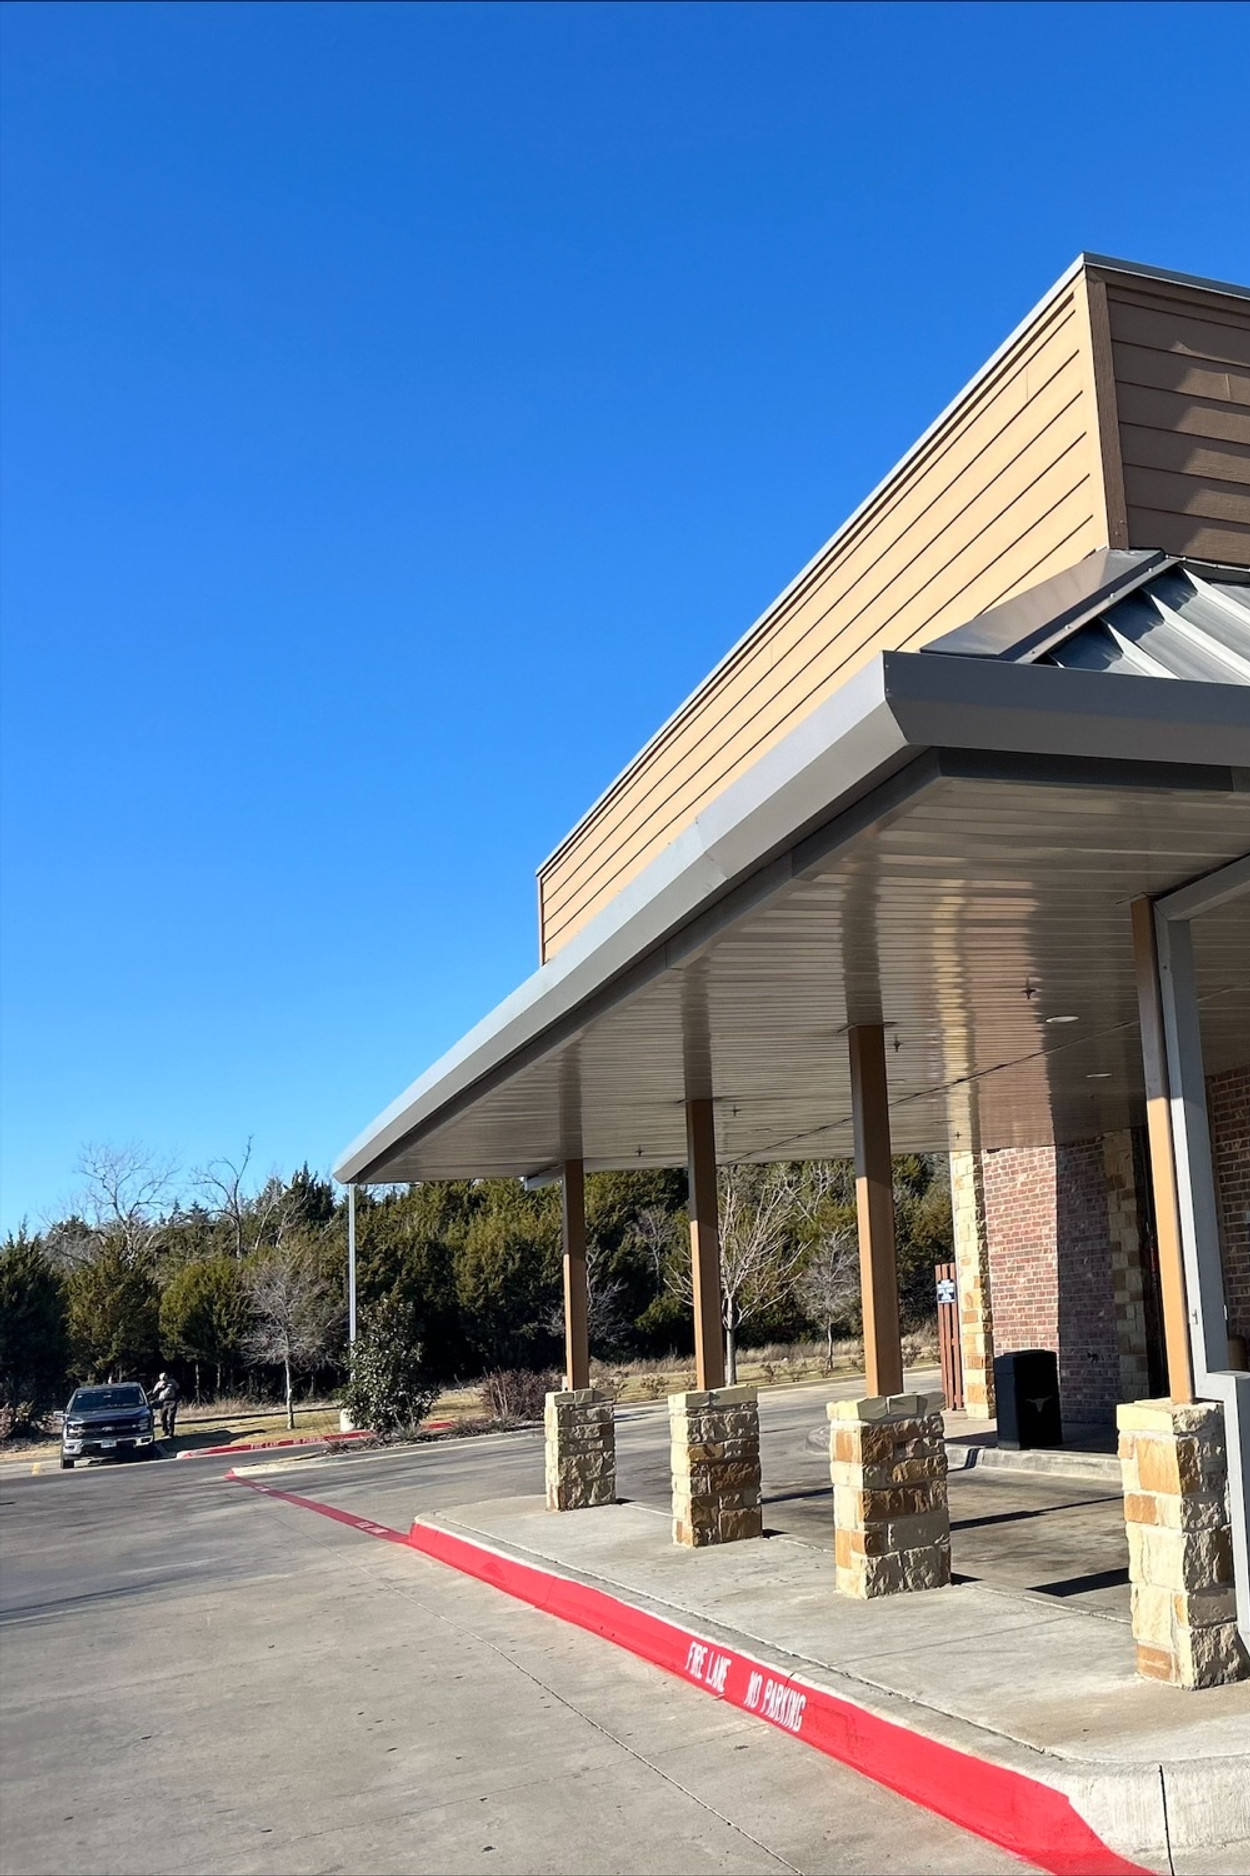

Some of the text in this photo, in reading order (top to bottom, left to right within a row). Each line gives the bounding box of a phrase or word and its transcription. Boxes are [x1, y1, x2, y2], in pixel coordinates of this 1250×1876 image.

[705, 1650, 733, 1693] LANE
[743, 1670, 807, 1732] NO PARKING
